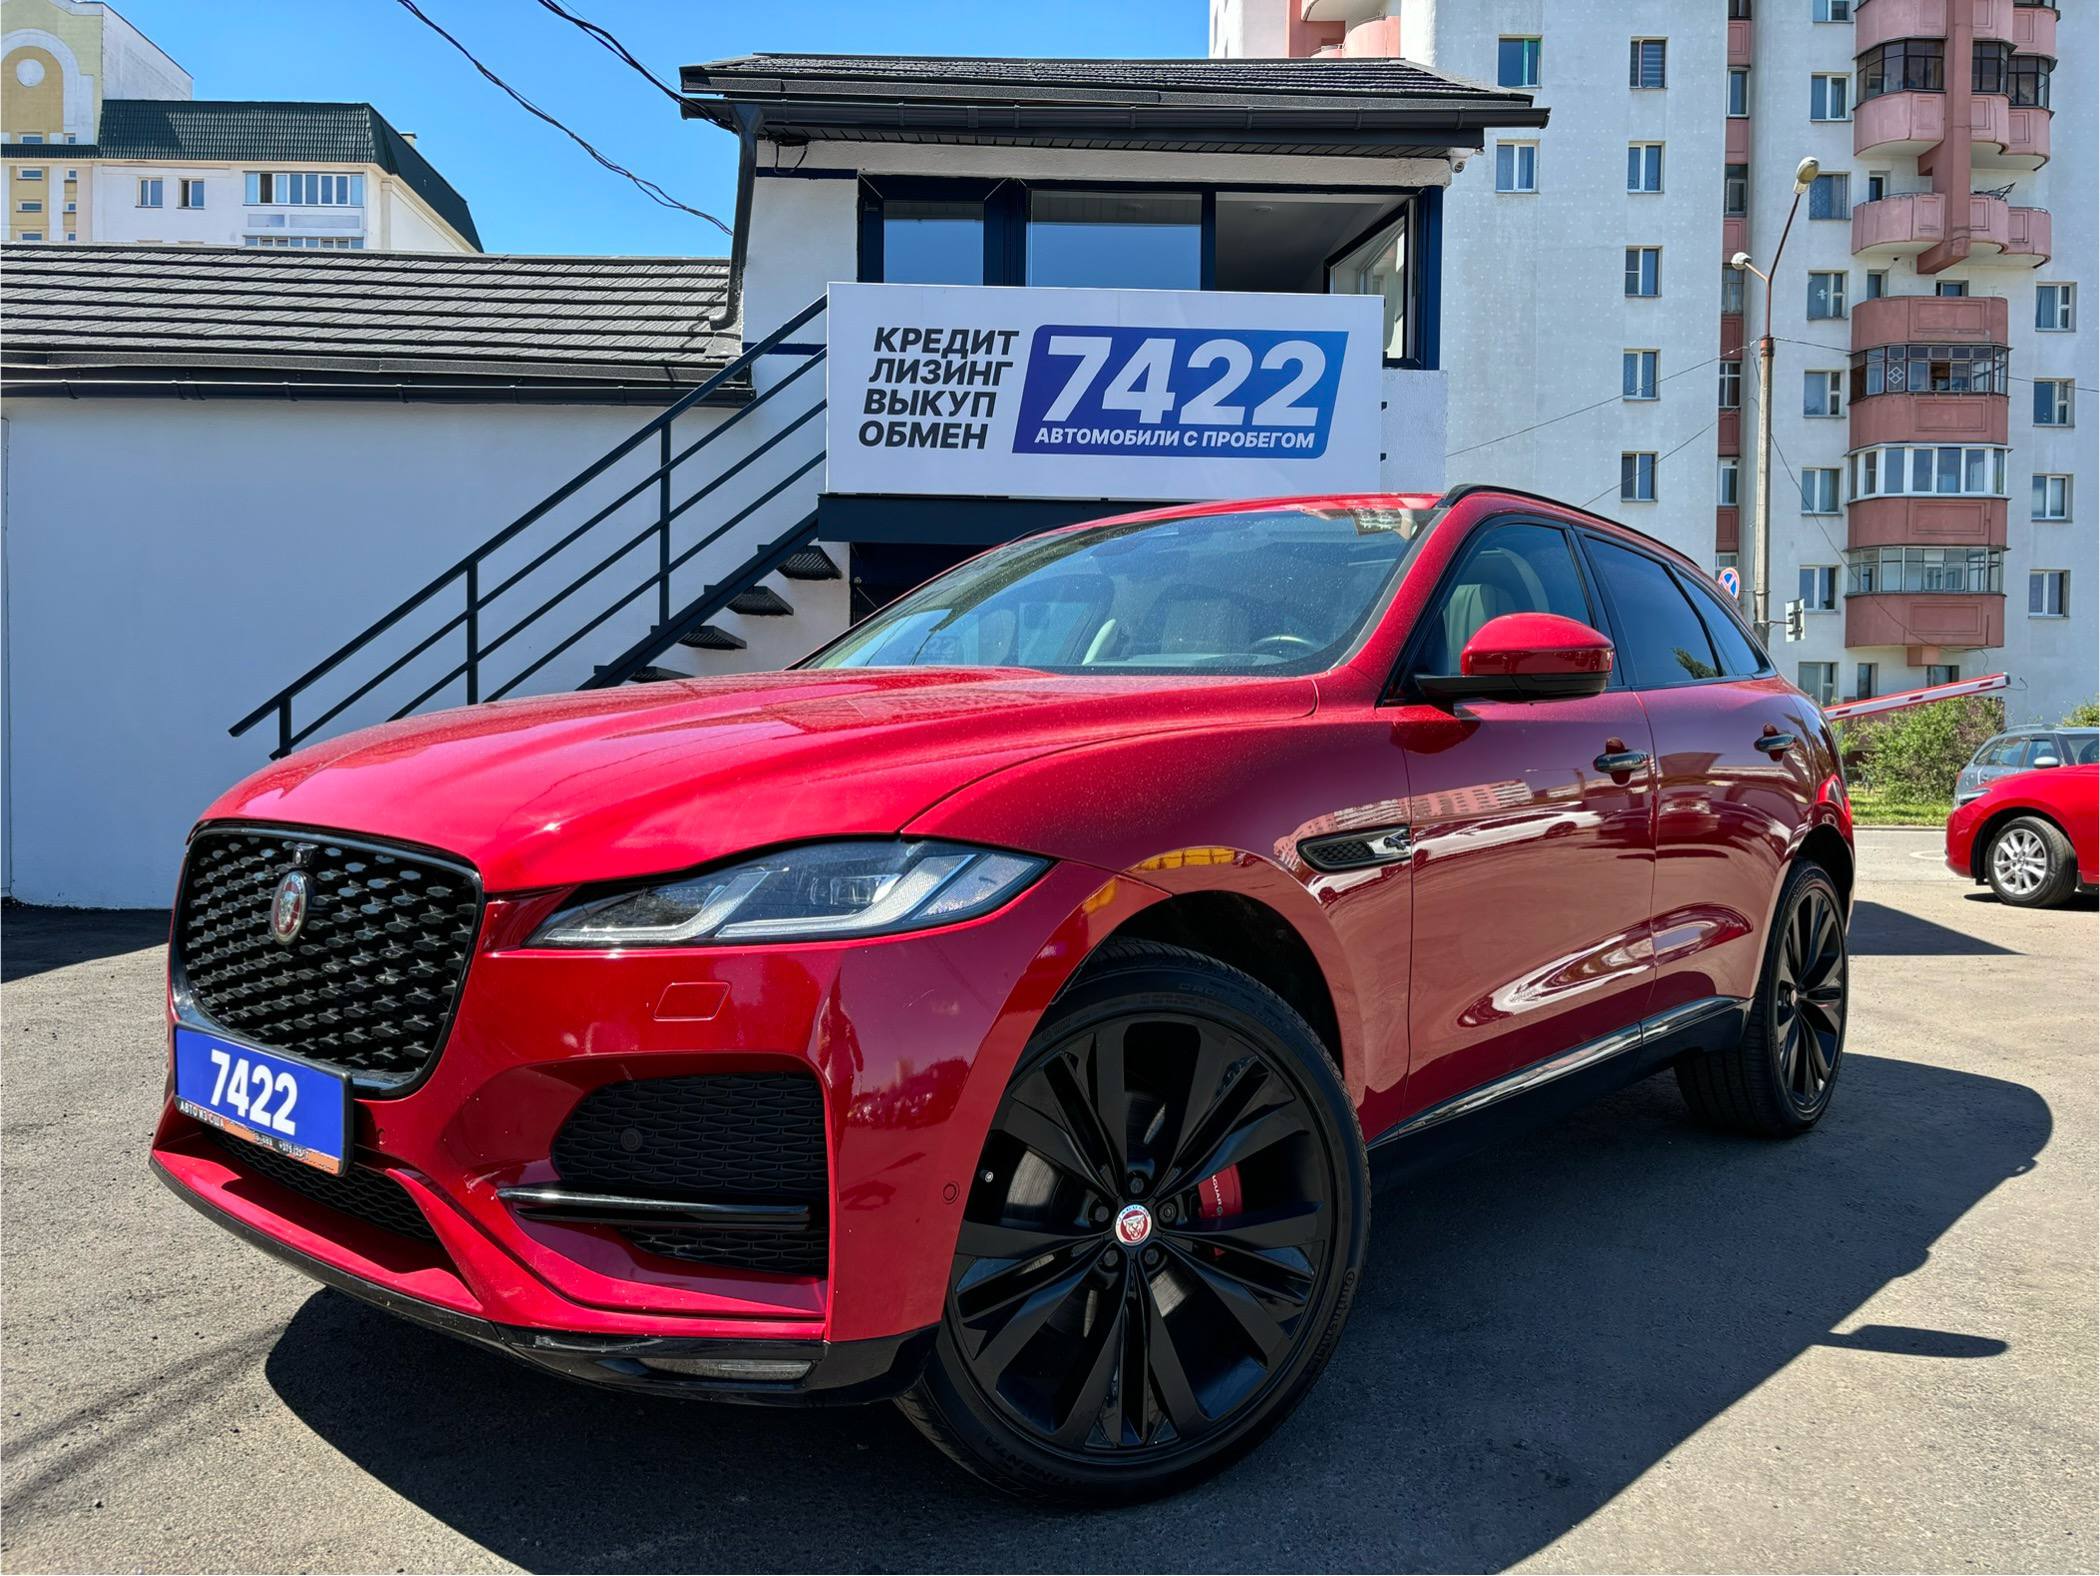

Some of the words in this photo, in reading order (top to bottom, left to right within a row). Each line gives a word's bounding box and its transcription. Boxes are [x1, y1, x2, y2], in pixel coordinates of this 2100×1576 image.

[873, 326, 1020, 357] КРЕДИТ
[868, 359, 1014, 388] ЛИЗИНГ
[1042, 335, 1327, 427] 7422
[862, 389, 997, 418] ВЫКУП
[858, 420, 989, 450] ОБМЕН
[1034, 427, 1181, 447] АВТОМОБИЛИ
[1183, 430, 1199, 447] С
[1201, 429, 1315, 449] ПРОБЕГОМ
[210, 1048, 298, 1136] 7422
